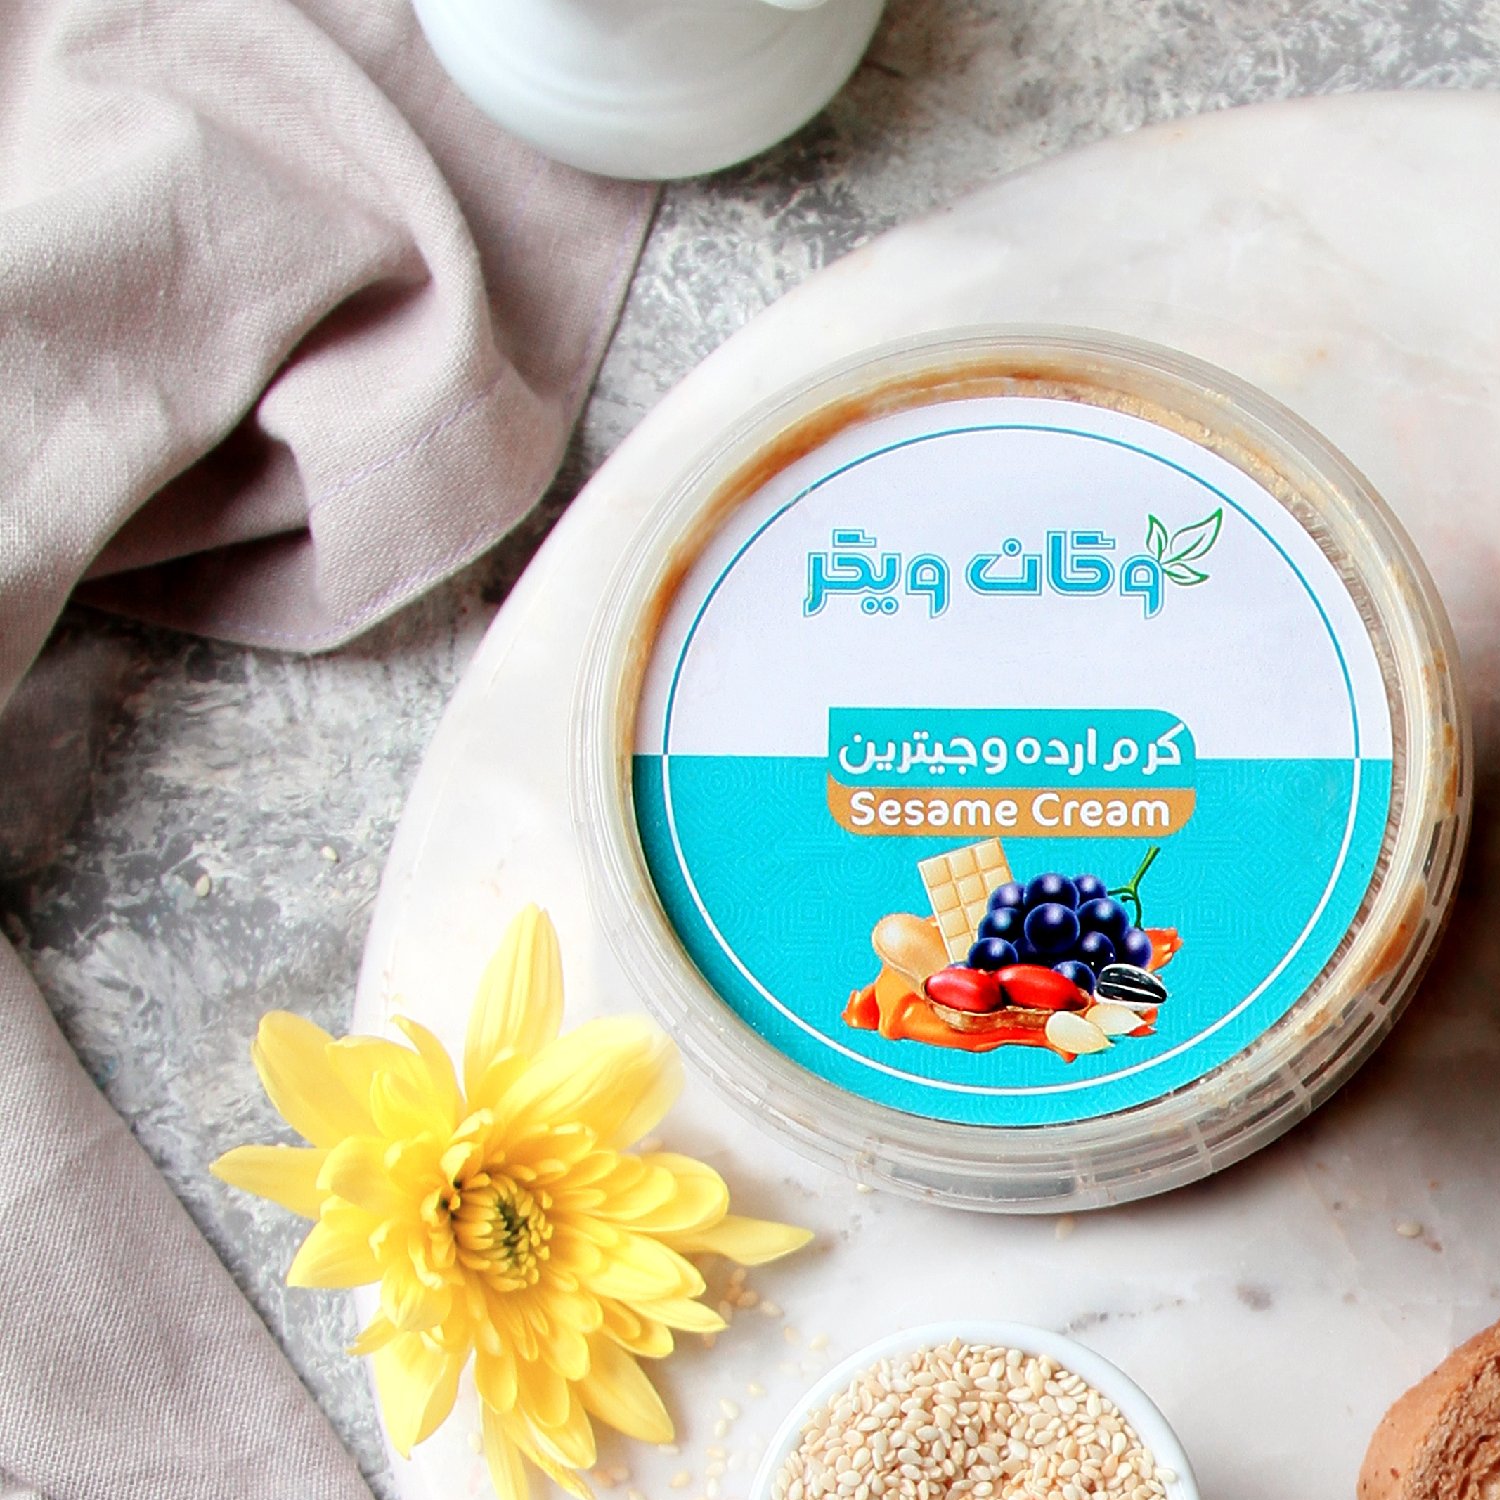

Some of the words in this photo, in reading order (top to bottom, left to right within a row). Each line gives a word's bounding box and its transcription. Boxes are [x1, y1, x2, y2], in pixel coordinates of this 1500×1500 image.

[964, 529, 1165, 620] وگان
[1015, 727, 1097, 776] ارده
[1102, 722, 1186, 776] کرم
[849, 790, 1019, 827] Sesame
[1031, 792, 1171, 827] Cream
